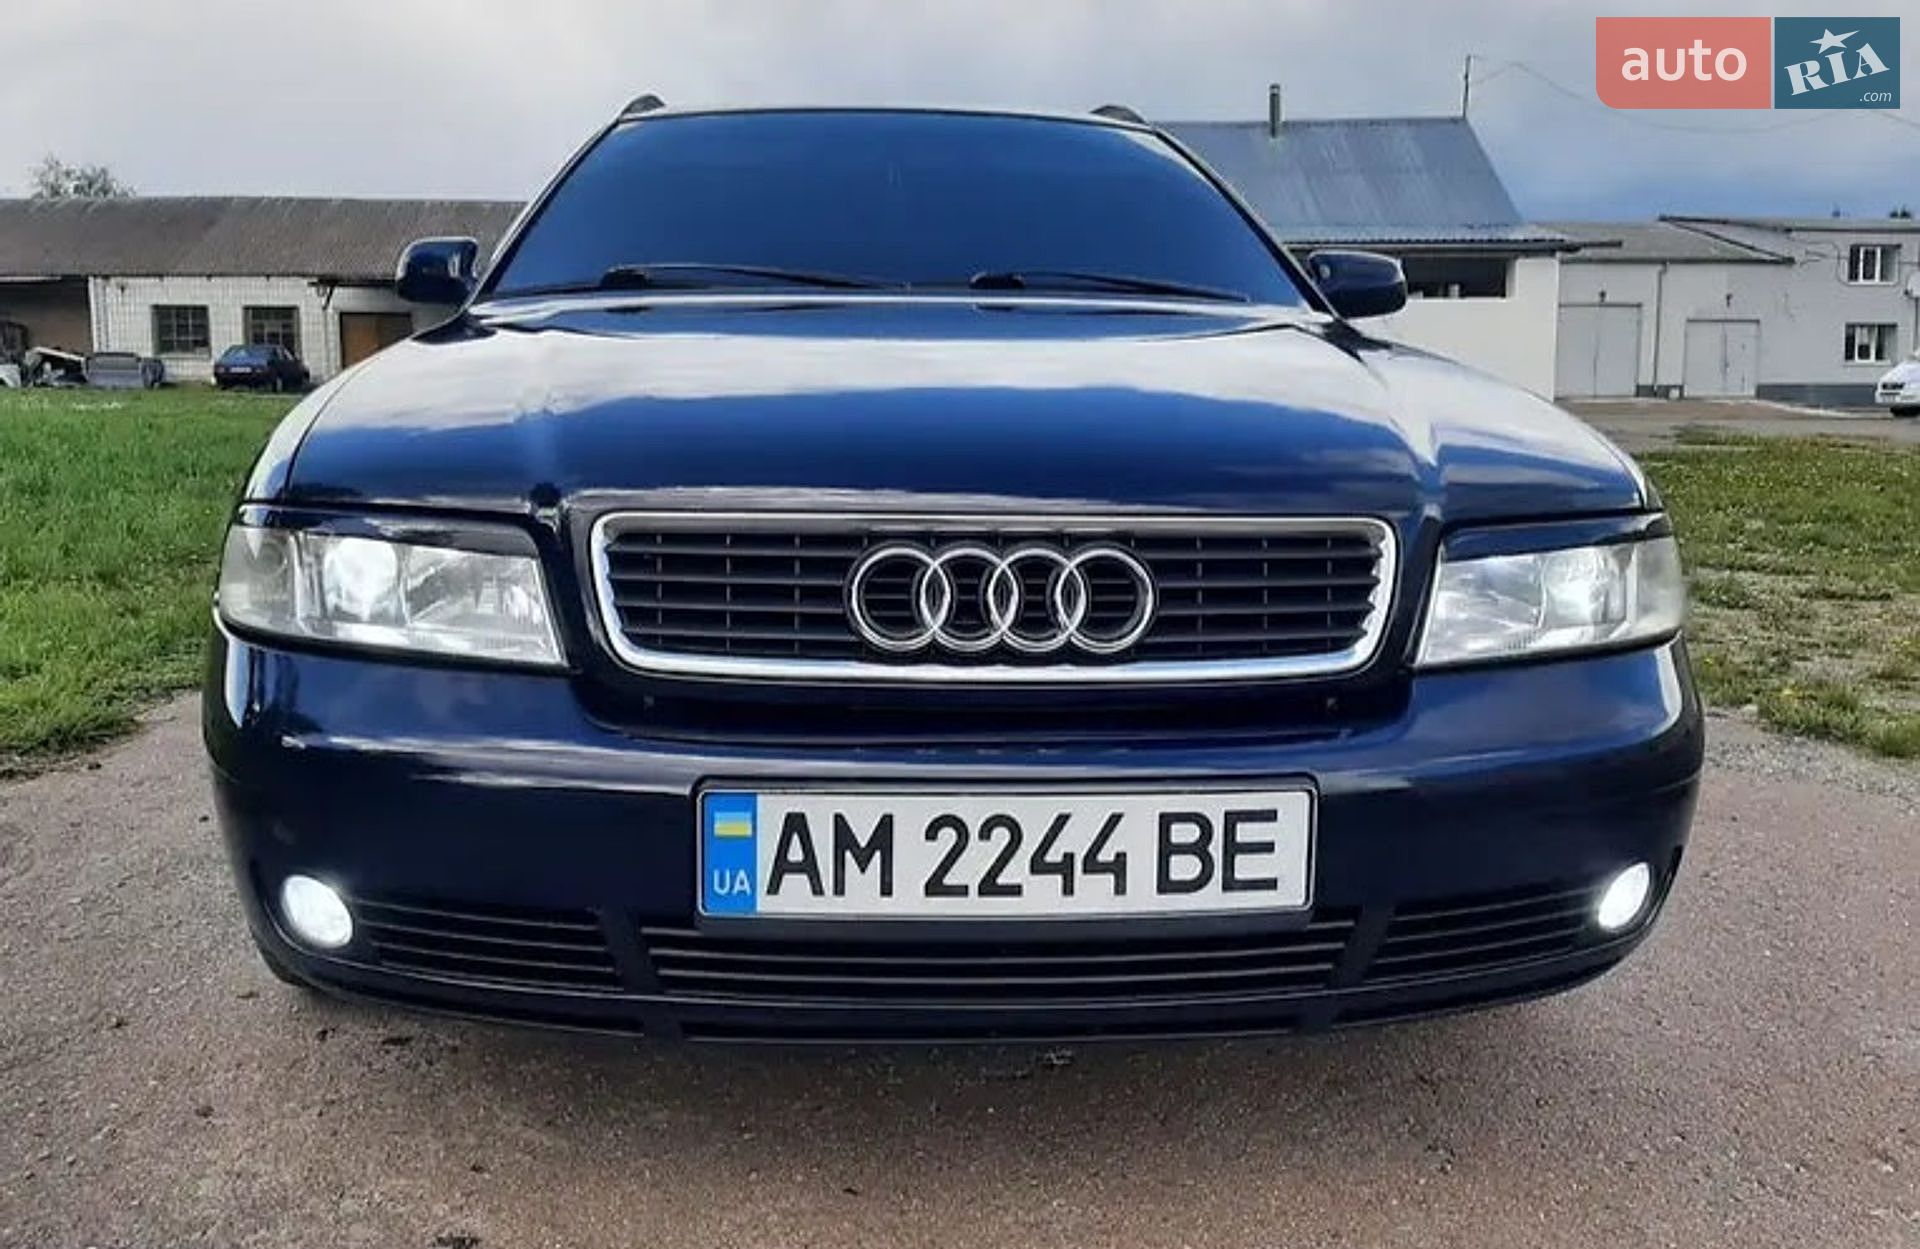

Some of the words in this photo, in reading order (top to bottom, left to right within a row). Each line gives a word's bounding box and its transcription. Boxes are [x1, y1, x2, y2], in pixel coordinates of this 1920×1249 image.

[765, 812, 894, 897] AM
[924, 813, 1127, 897] 2244
[1156, 809, 1279, 897] BE
[713, 870, 751, 896] UA
